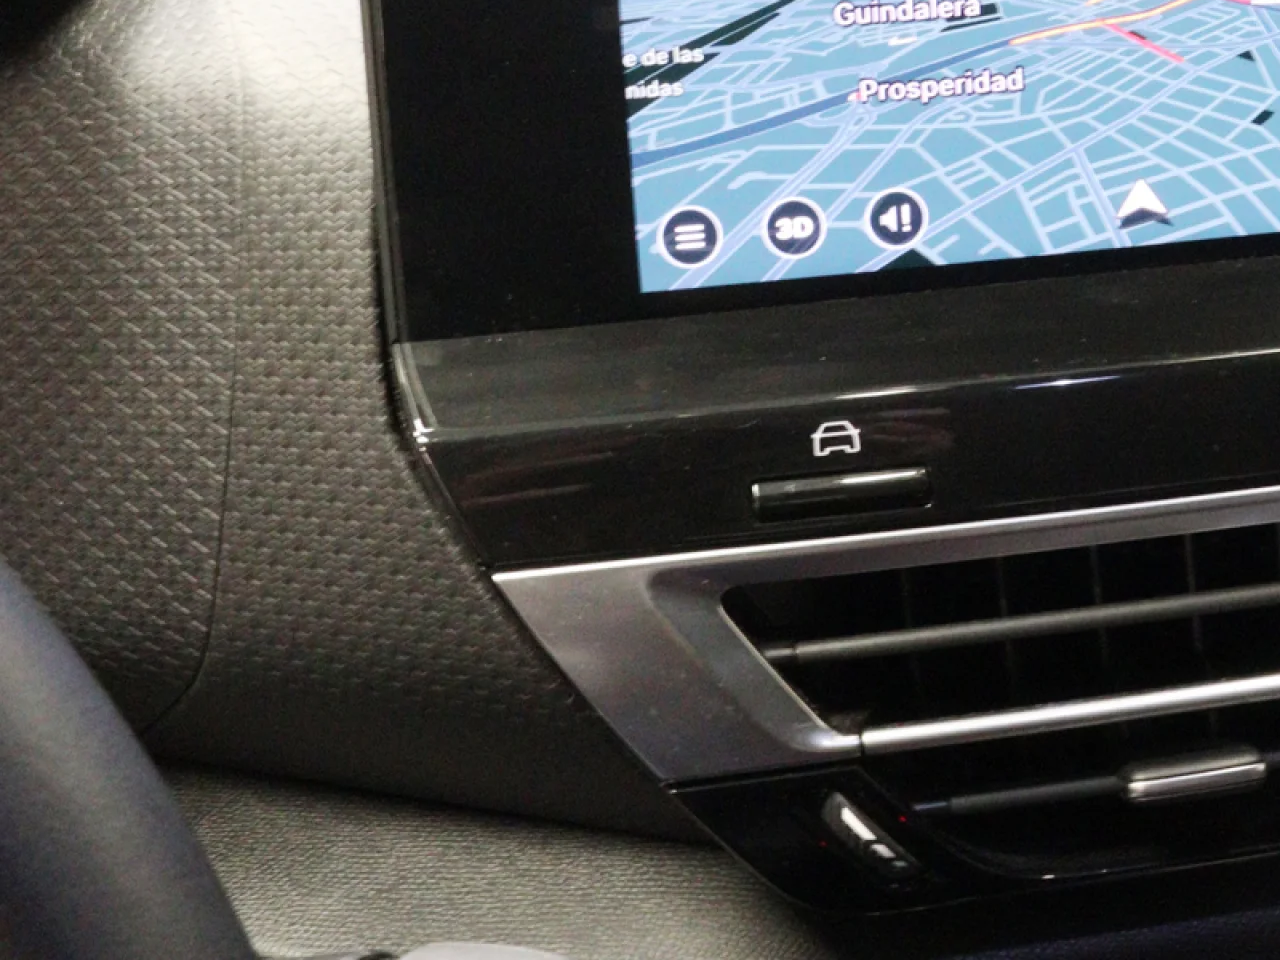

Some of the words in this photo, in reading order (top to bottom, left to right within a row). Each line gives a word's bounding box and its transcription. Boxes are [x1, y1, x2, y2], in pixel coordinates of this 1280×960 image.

[641, 48, 668, 66] de
[672, 46, 705, 63] las
[624, 79, 684, 100] nidas
[858, 66, 1025, 104] Prosperidad
[774, 215, 815, 241] 3D
